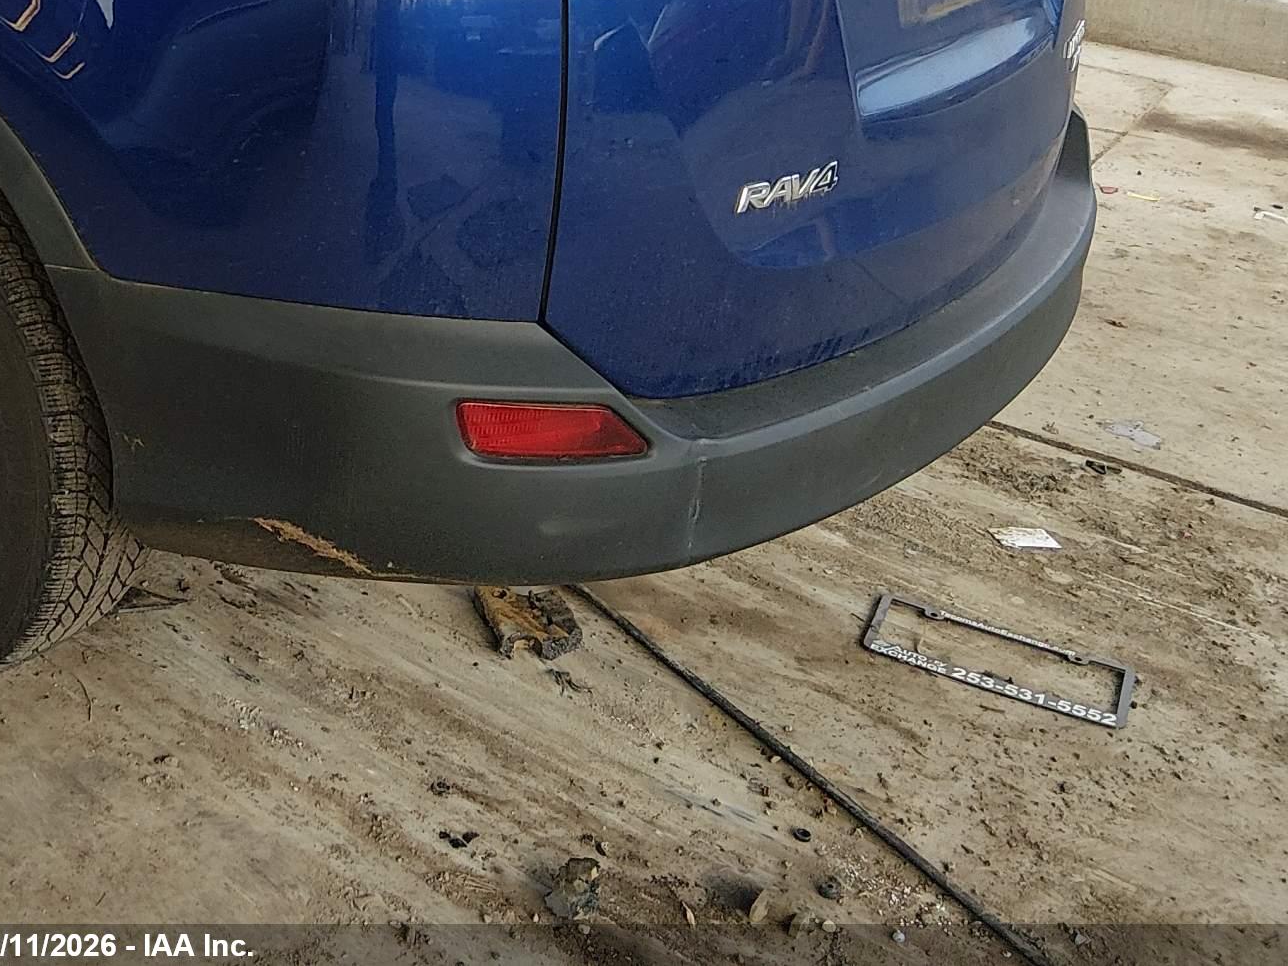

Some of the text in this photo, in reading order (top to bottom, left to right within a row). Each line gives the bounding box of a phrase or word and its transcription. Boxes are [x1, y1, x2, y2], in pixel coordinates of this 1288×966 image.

[736, 160, 839, 213] RAV4
[869, 643, 948, 675] EXCHANGE
[950, 666, 1119, 726] 253-531-5552
